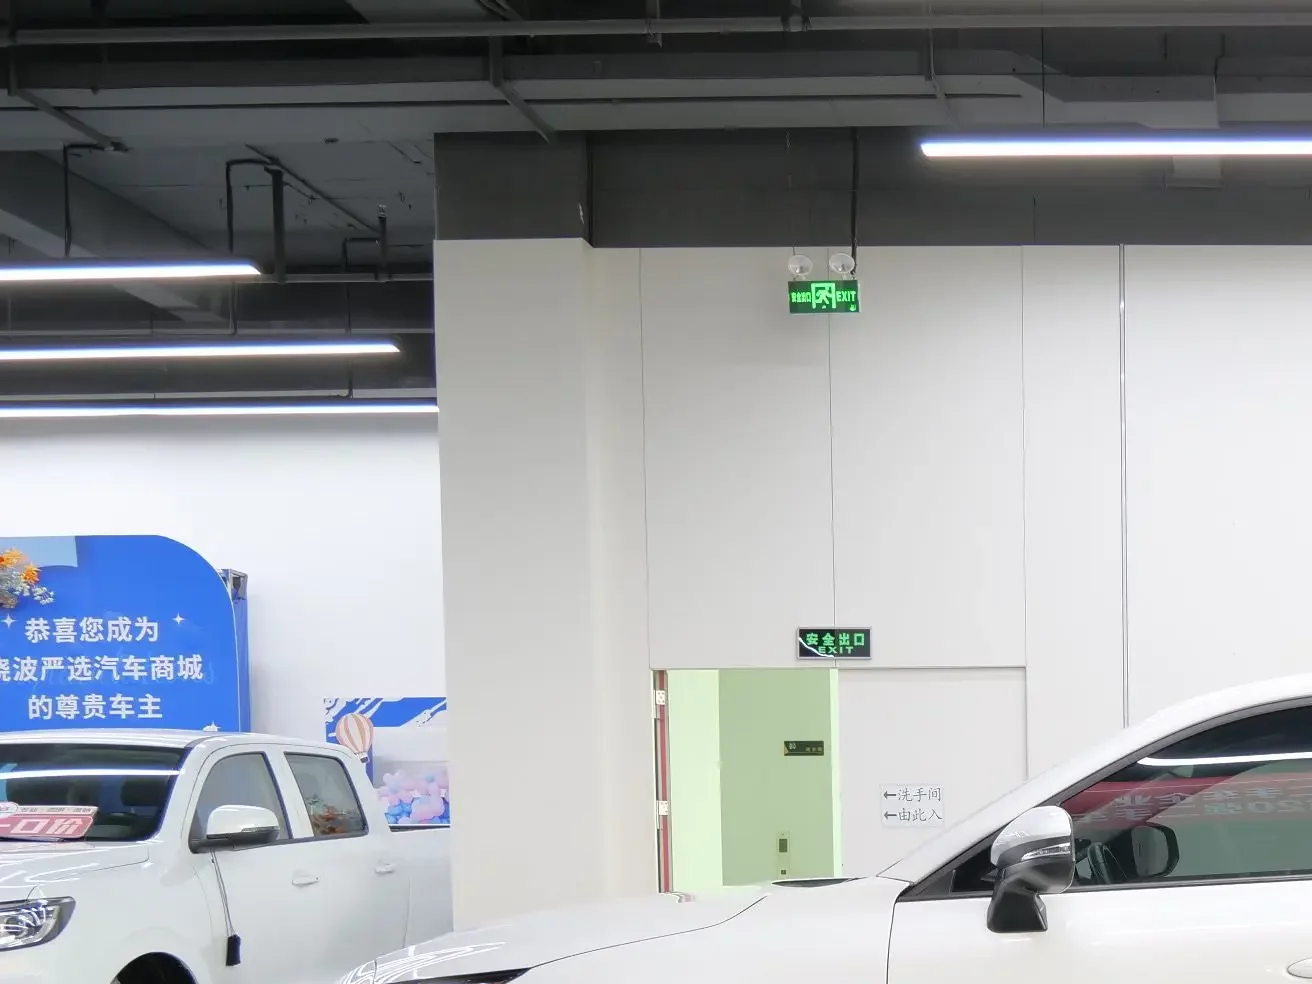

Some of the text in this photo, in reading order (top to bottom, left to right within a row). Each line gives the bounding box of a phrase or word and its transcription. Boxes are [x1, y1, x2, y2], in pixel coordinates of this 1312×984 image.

[836, 290, 856, 302] EXIT
[25, 616, 159, 643] 恭喜您成为
[806, 632, 865, 646] 安全出口
[818, 646, 854, 654] EXIT
[28, 693, 163, 720] 的尊贵车主
[898, 787, 941, 802] 洗手间
[899, 807, 943, 822] 由此入
